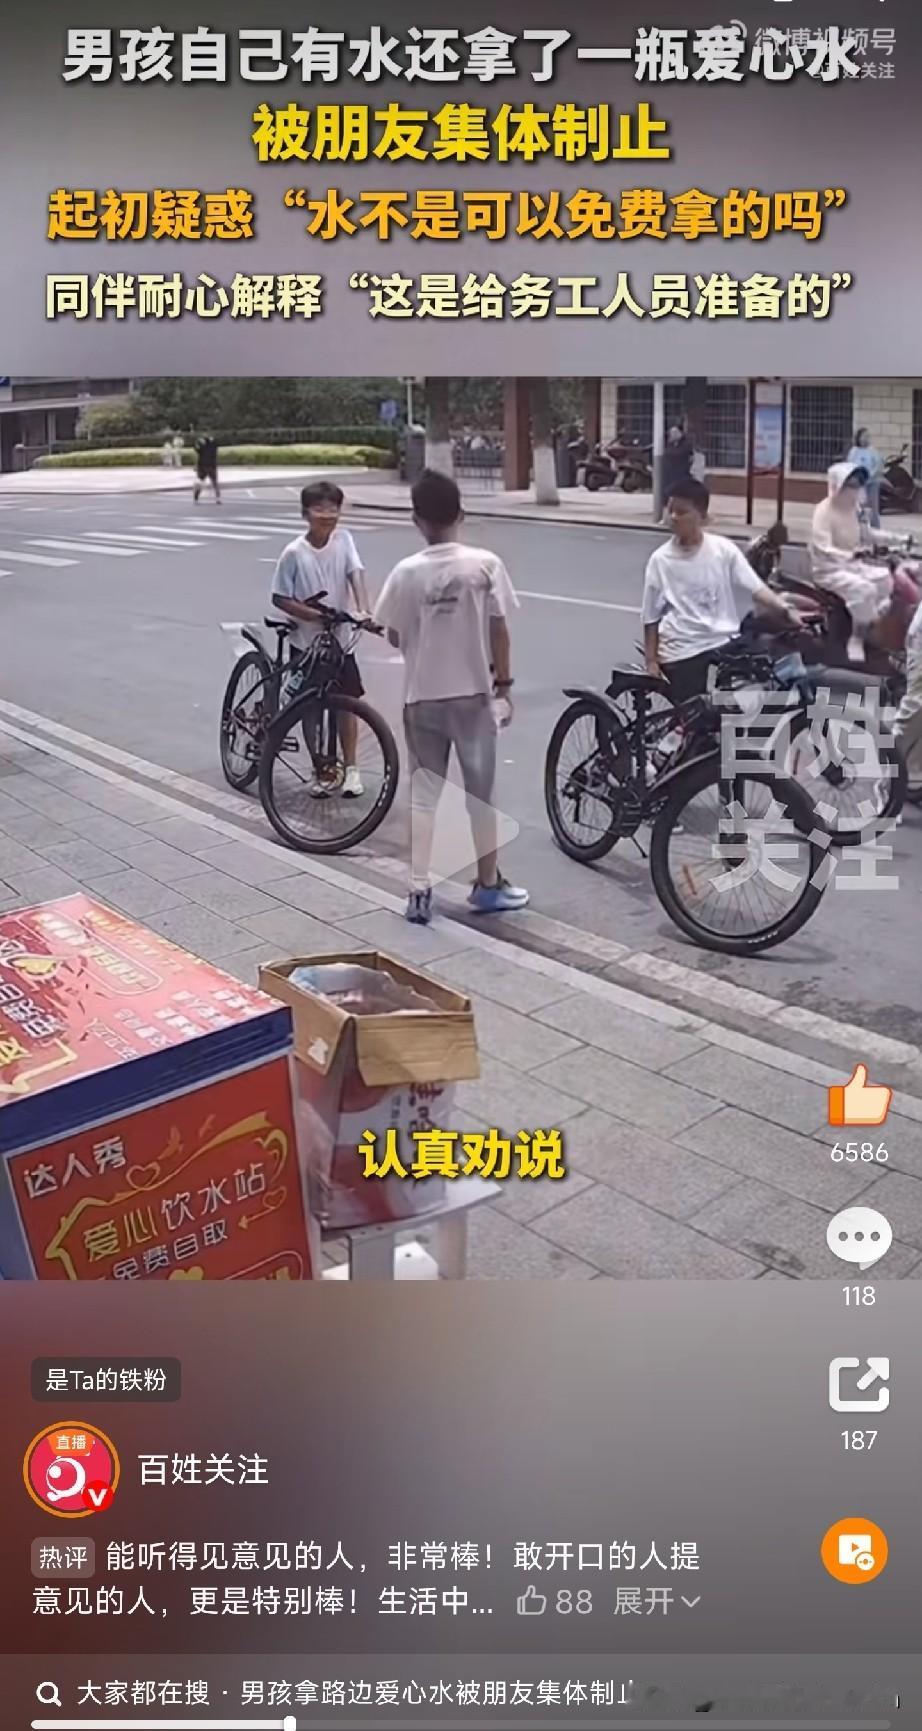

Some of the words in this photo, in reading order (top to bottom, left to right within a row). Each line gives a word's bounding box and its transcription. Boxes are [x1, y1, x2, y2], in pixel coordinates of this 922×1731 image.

[24, 1135, 127, 1200] 达人秀
[84, 1162, 268, 1264] 爱心饮水站
[113, 1219, 229, 1280] 免费自取
